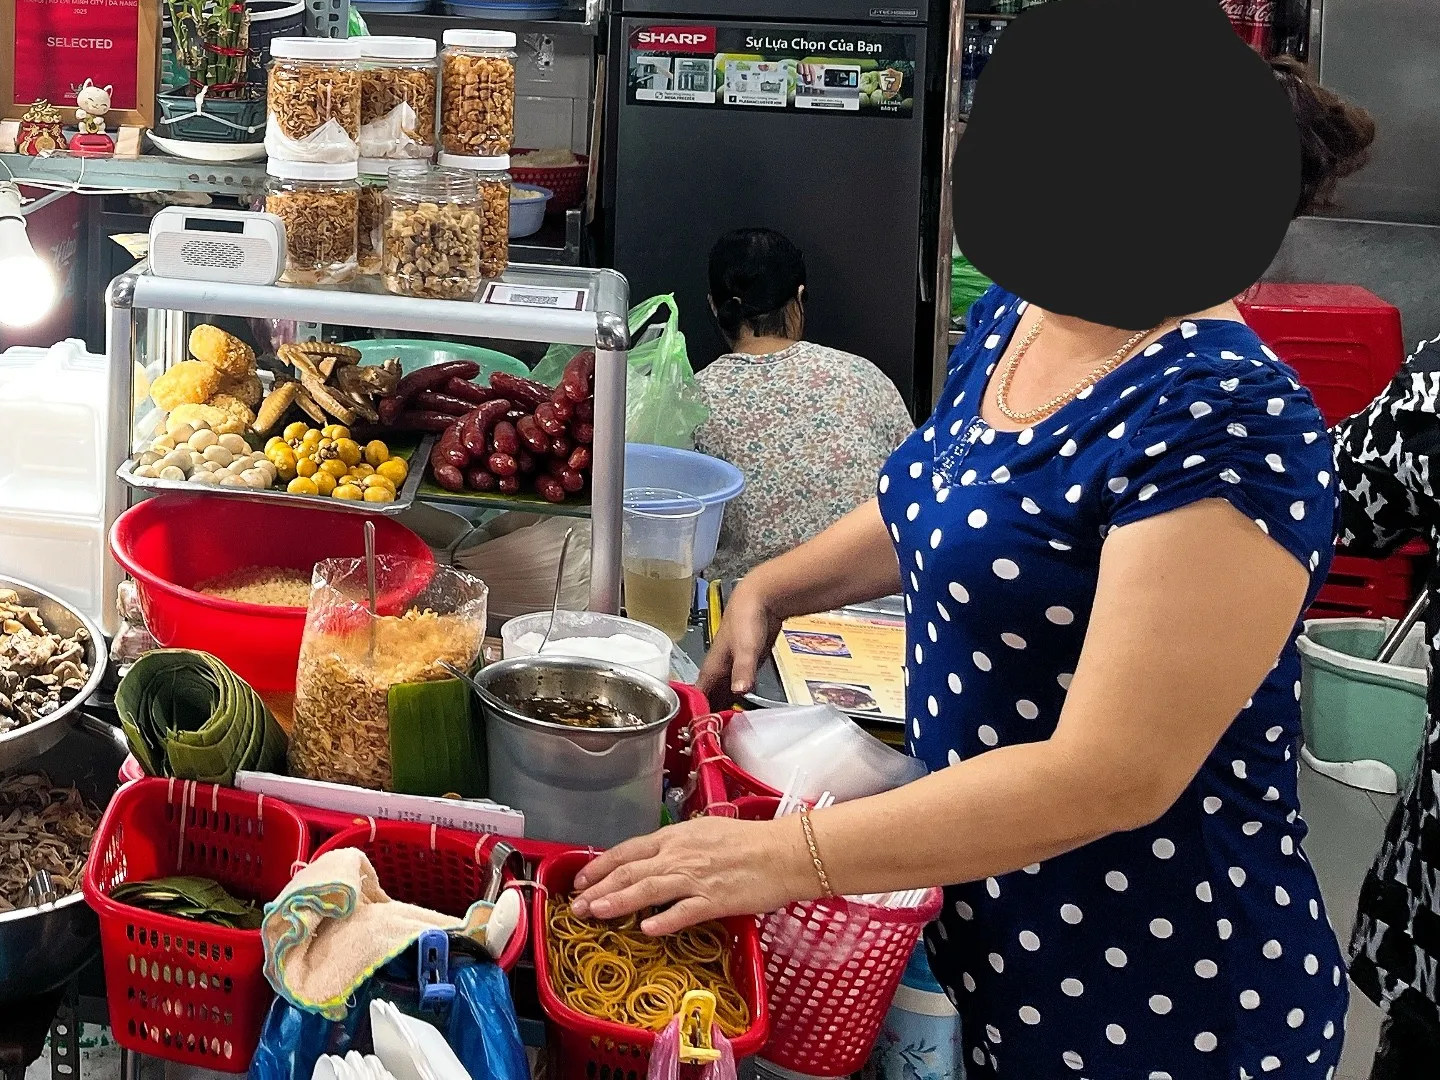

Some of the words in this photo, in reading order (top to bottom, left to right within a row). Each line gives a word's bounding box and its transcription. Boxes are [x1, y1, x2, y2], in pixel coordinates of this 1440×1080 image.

[46, 36, 113, 49] SELECTED
[638, 32, 707, 44] SHARP
[746, 36, 762, 50] Sự
[765, 37, 787, 51] Lựa
[791, 38, 825, 52] Chọn
[829, 39, 853, 52] Của
[858, 41, 882, 55] Bạn
